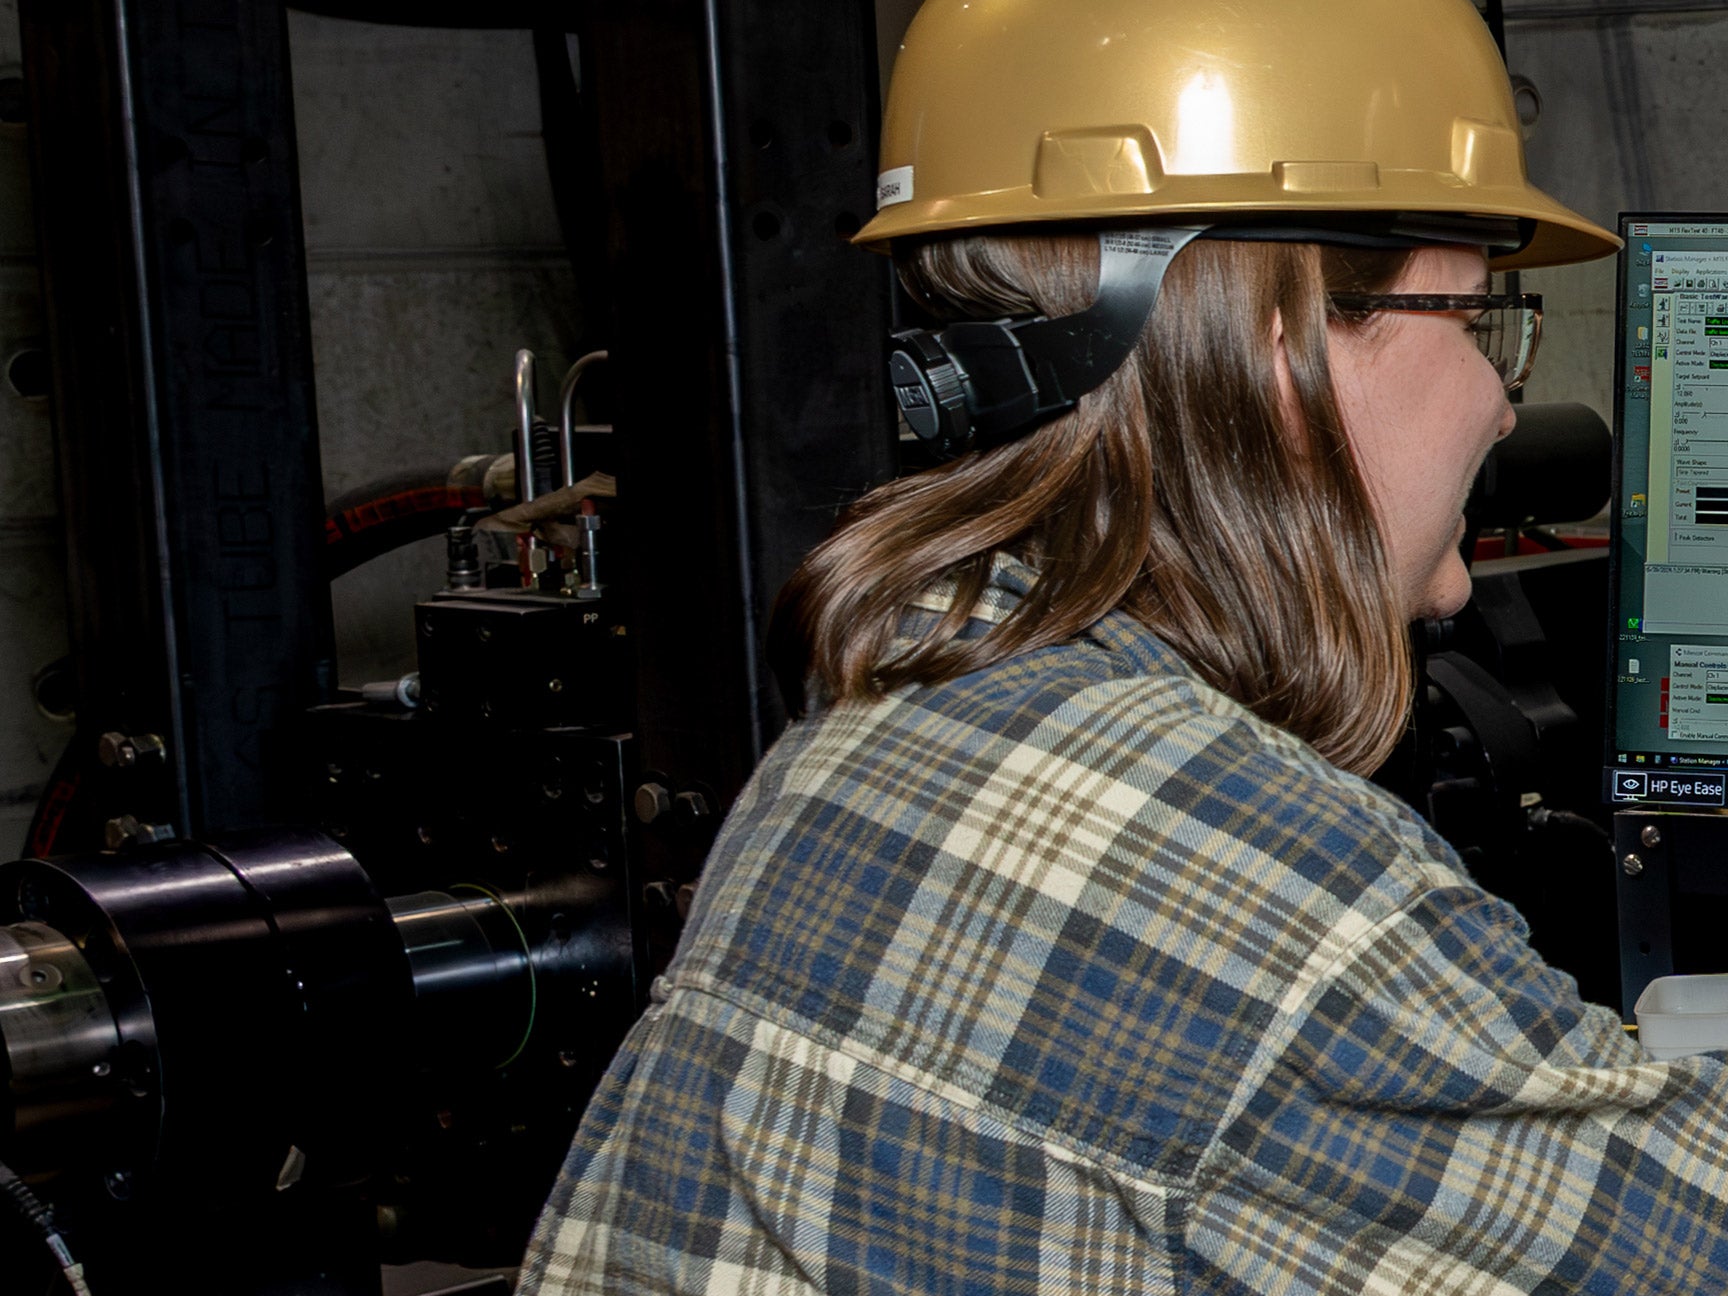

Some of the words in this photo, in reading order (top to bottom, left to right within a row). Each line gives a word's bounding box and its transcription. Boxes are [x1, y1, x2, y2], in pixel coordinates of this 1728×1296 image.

[1674, 661, 1699, 669] Manual
[1650, 779, 1668, 793] HP
[1670, 780, 1692, 797] Eye
[1694, 781, 1723, 796] Ease
